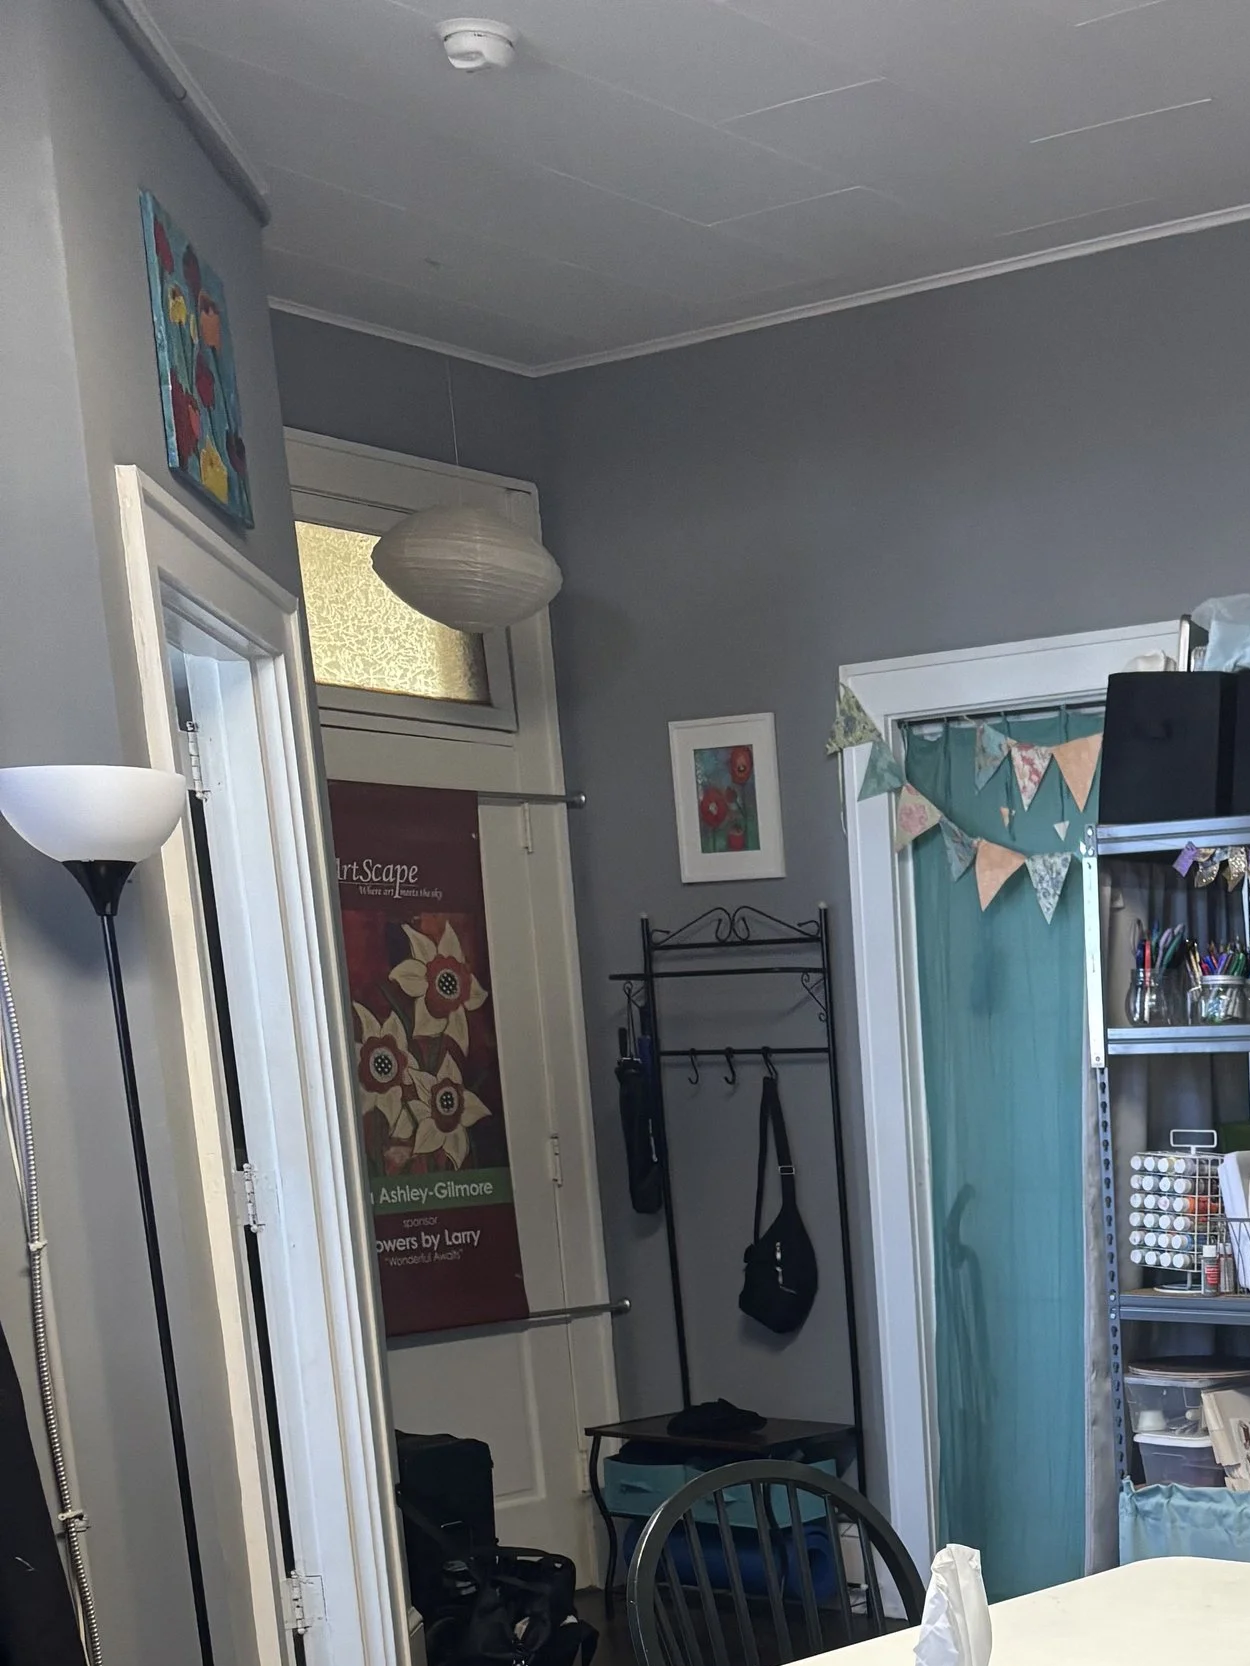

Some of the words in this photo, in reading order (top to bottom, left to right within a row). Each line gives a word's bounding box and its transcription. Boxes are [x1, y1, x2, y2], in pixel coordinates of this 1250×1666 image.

[360, 886, 381, 896] Where
[383, 888, 394, 896] art
[400, 889, 419, 897] meets
[420, 888, 430, 897] the
[431, 888, 442, 900] sky
[380, 1181, 493, 1205] Ashley-Gilmore
[403, 1216, 438, 1228] sponsor
[376, 1237, 418, 1253] owers
[421, 1231, 440, 1250] by
[445, 1229, 480, 1246] Larry
